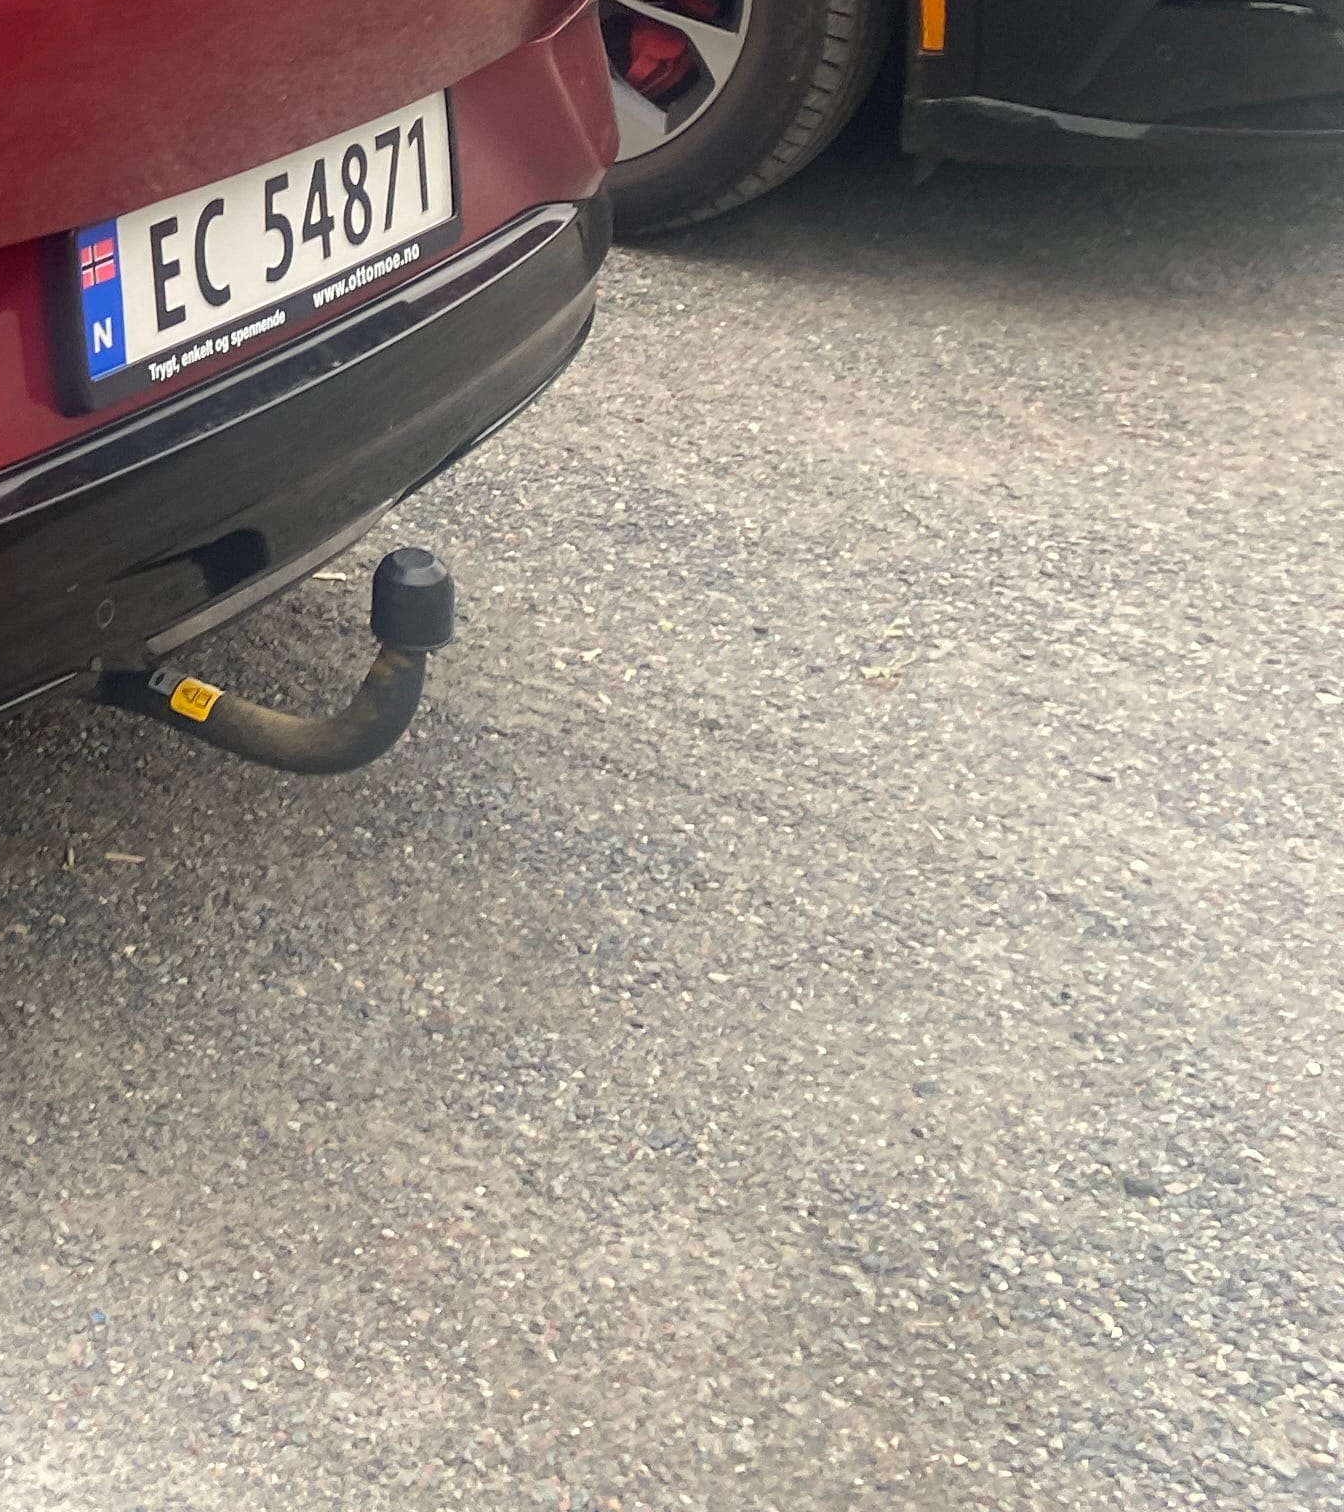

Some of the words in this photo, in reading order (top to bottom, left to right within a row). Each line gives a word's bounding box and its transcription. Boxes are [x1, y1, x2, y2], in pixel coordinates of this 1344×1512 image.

[150, 198, 231, 332] EC
[264, 116, 429, 283] 54871
[312, 243, 421, 308] www.ottomoe.no
[93, 317, 113, 354] N
[148, 355, 180, 381] Trygt,
[181, 337, 214, 367] enkelt
[215, 334, 230, 353] og
[231, 309, 286, 347] spennende
